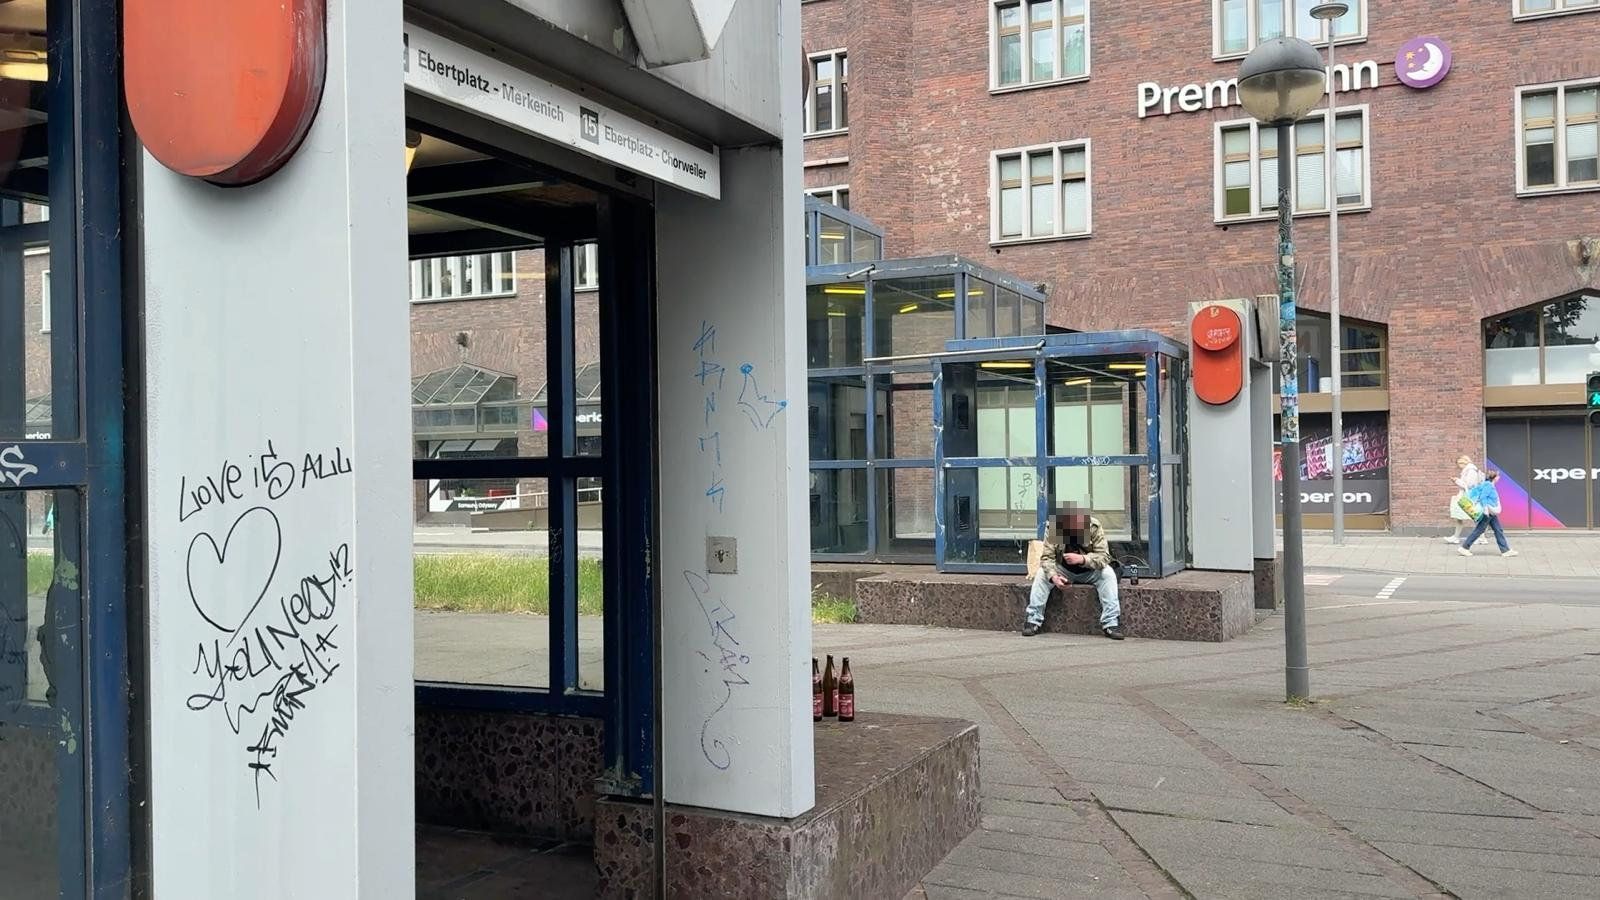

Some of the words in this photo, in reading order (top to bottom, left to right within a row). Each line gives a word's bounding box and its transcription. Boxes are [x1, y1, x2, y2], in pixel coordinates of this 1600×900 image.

[417, 49, 490, 93] Ebertplatz
[502, 82, 565, 123] Merkenich
[1137, 76, 1242, 119] Prem
[1325, 58, 1379, 94] nn
[582, 113, 597, 137] 15
[604, 124, 654, 159] Ebertplatz
[661, 149, 707, 181] Chorweiler
